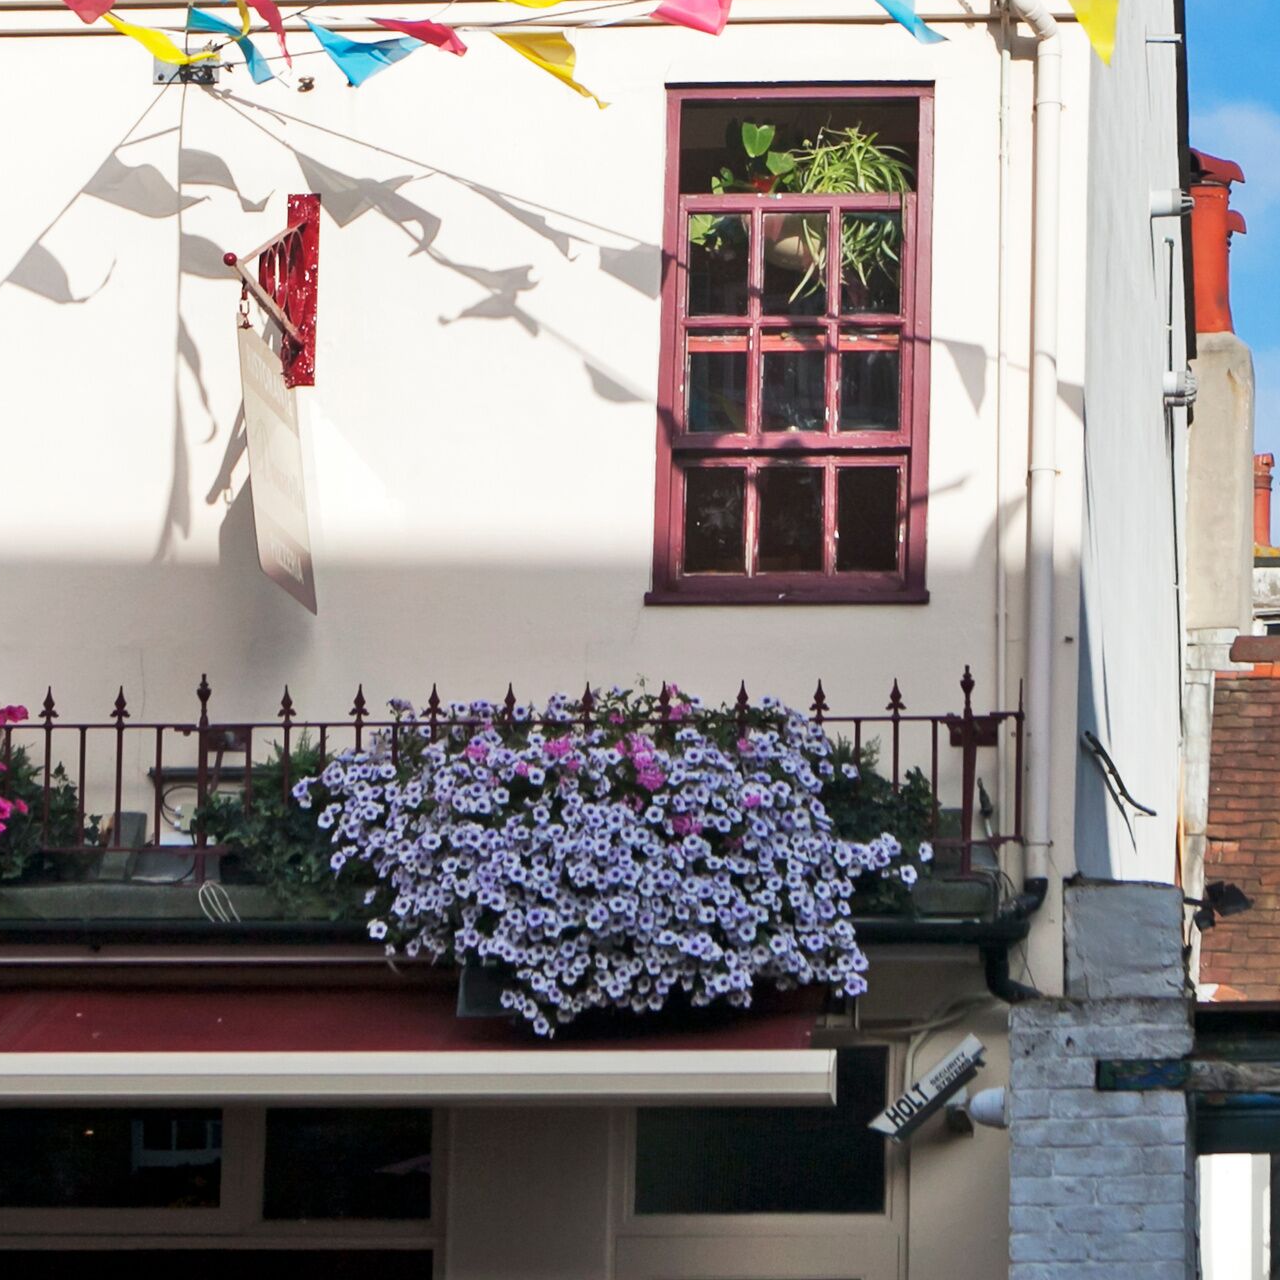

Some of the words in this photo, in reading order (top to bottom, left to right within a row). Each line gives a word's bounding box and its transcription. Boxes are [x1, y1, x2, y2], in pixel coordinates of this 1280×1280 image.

[929, 1051, 966, 1086] SECURITY
[935, 1056, 972, 1091] SYSTEMS
[885, 1082, 928, 1129] HOLT
